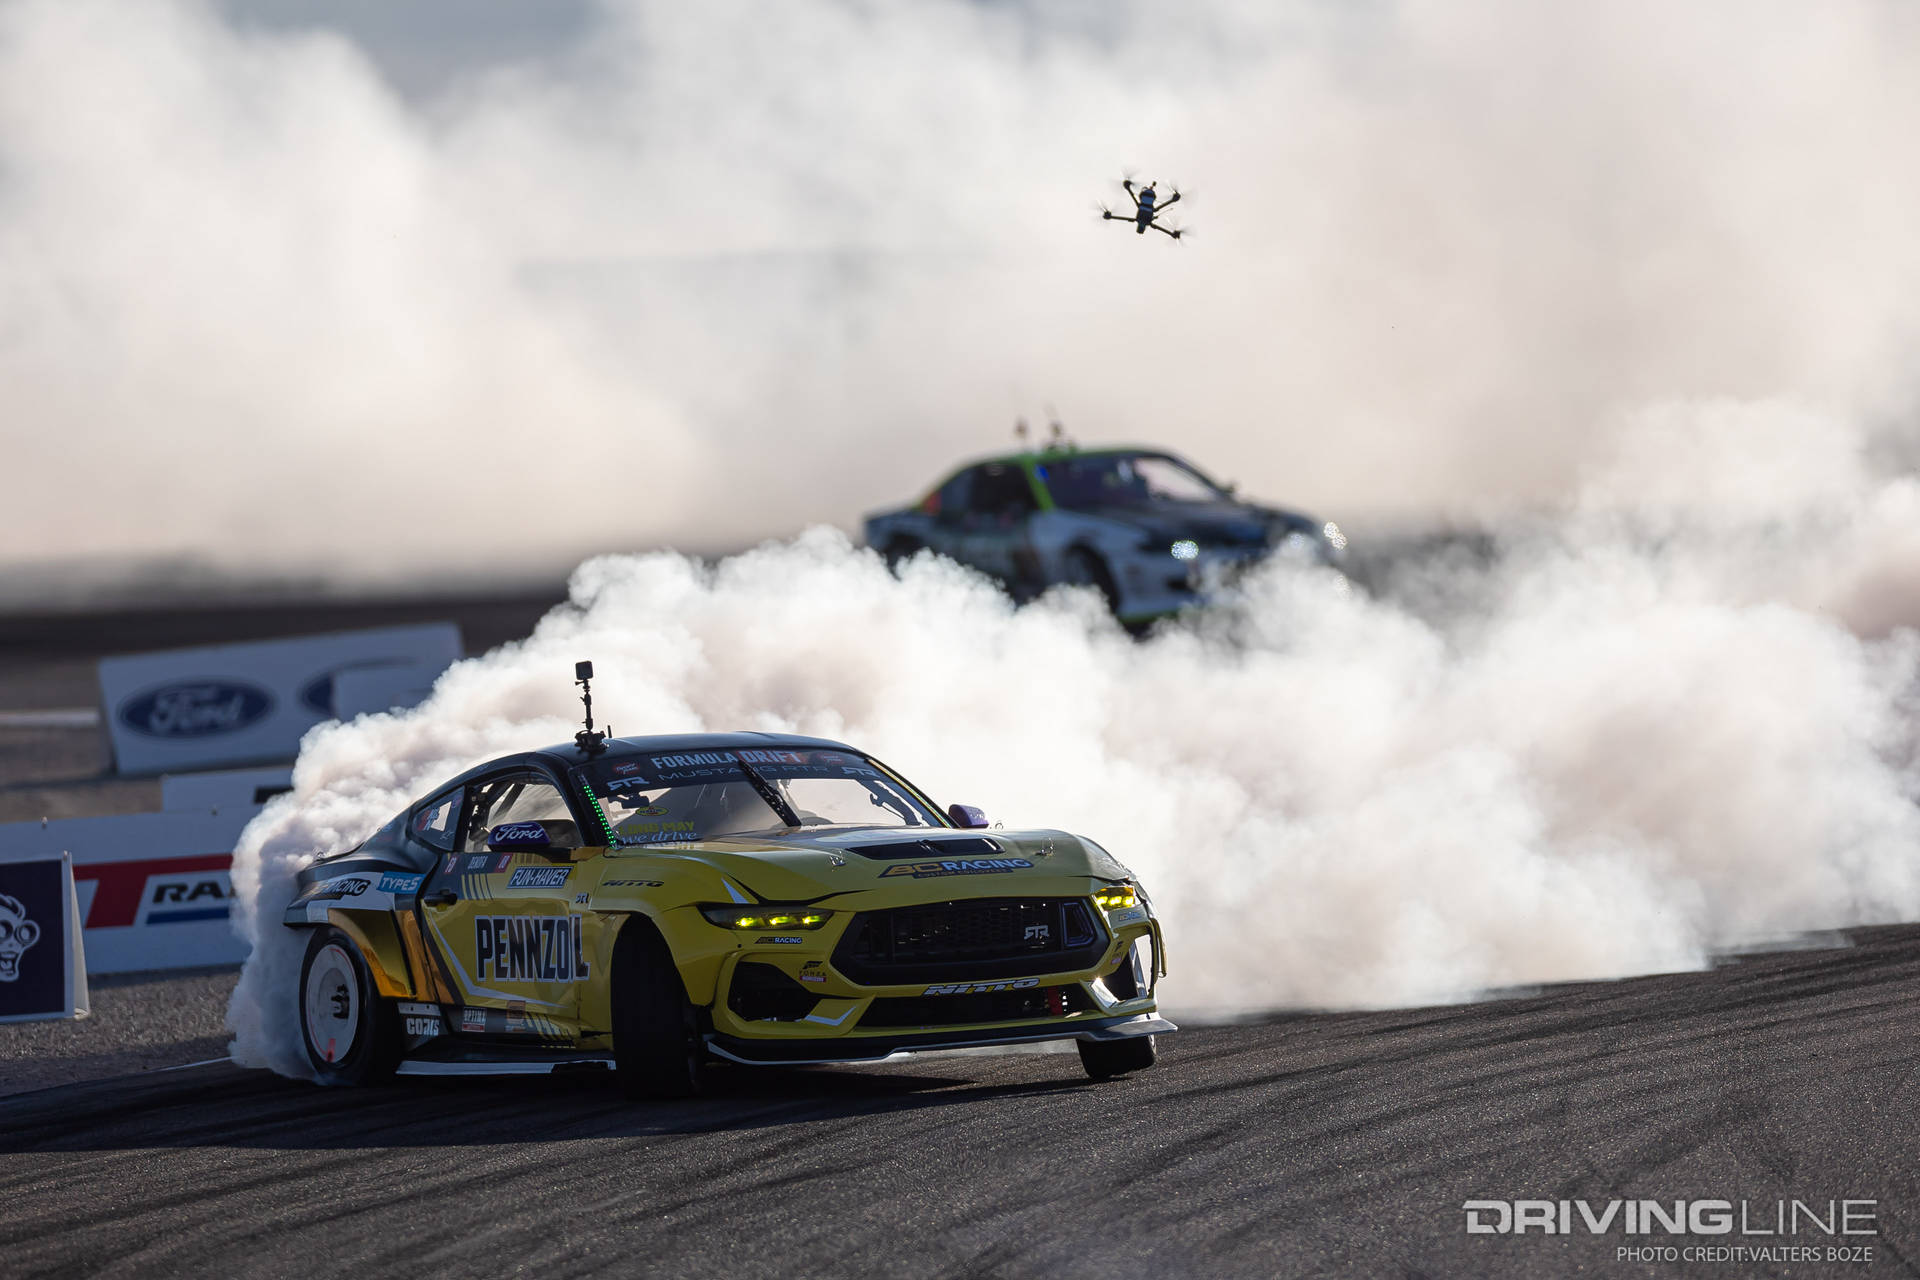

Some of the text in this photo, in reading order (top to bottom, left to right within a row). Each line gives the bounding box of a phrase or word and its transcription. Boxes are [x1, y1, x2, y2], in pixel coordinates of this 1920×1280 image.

[148, 684, 244, 734] Ford
[651, 752, 738, 769] FORMULA
[738, 751, 800, 764] DRIFT
[658, 764, 777, 781] MUSTAG
[495, 824, 545, 841] Ford
[662, 821, 695, 832] MAY
[621, 831, 697, 845] we drive
[510, 868, 569, 885] FUN-HAVER
[924, 978, 1040, 996] NITTO
